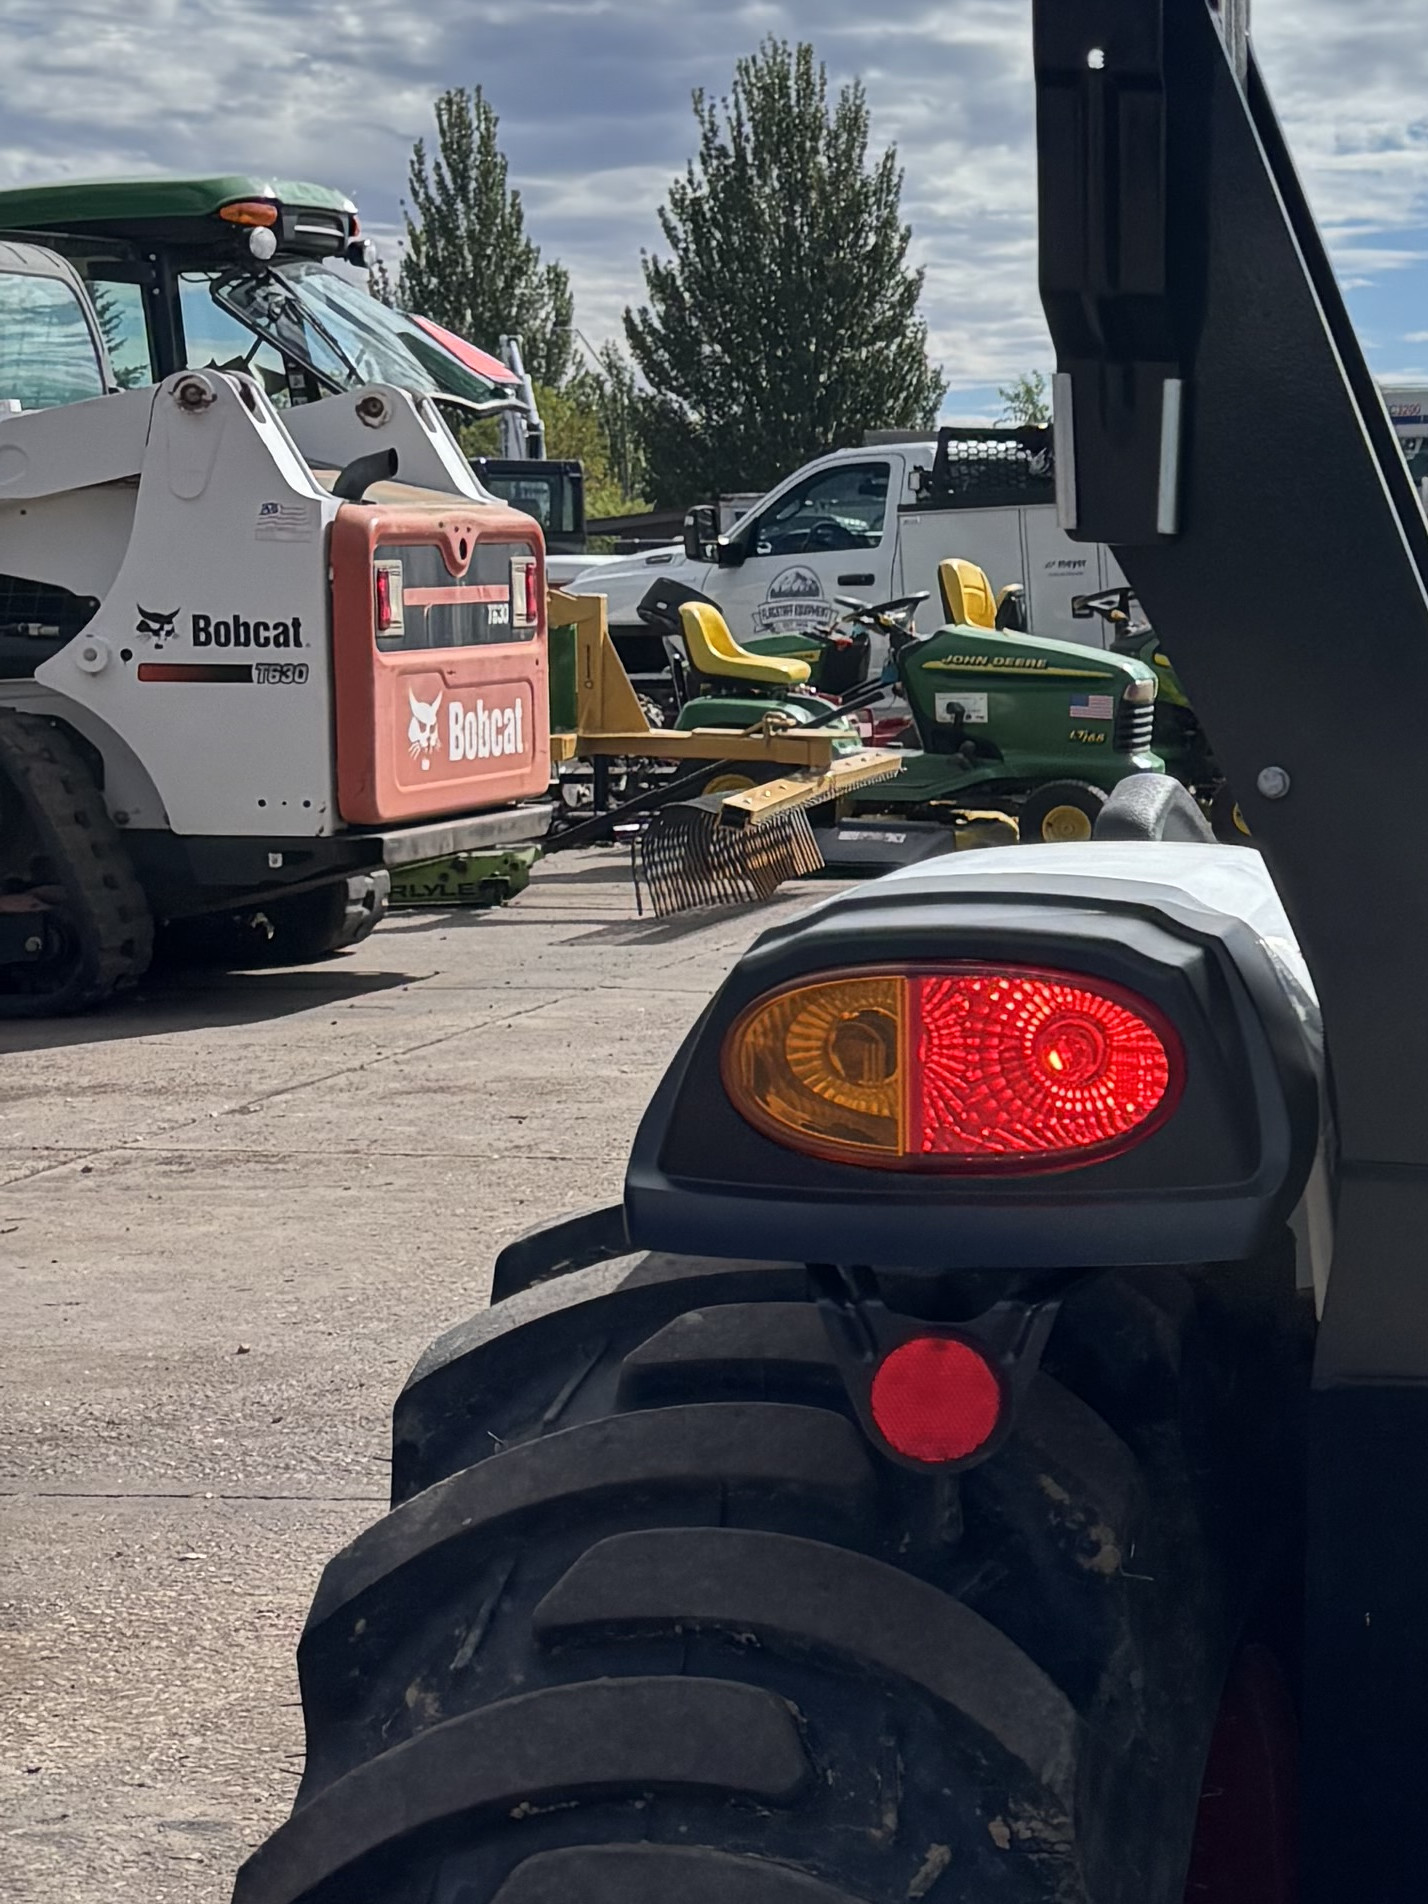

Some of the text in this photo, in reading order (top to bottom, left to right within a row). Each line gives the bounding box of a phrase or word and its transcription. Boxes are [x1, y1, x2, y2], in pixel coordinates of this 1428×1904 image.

[192, 614, 303, 649] Bobcat
[254, 662, 310, 684] T630
[941, 654, 1049, 670] JOHN DEERE
[448, 698, 524, 762] Bobcat
